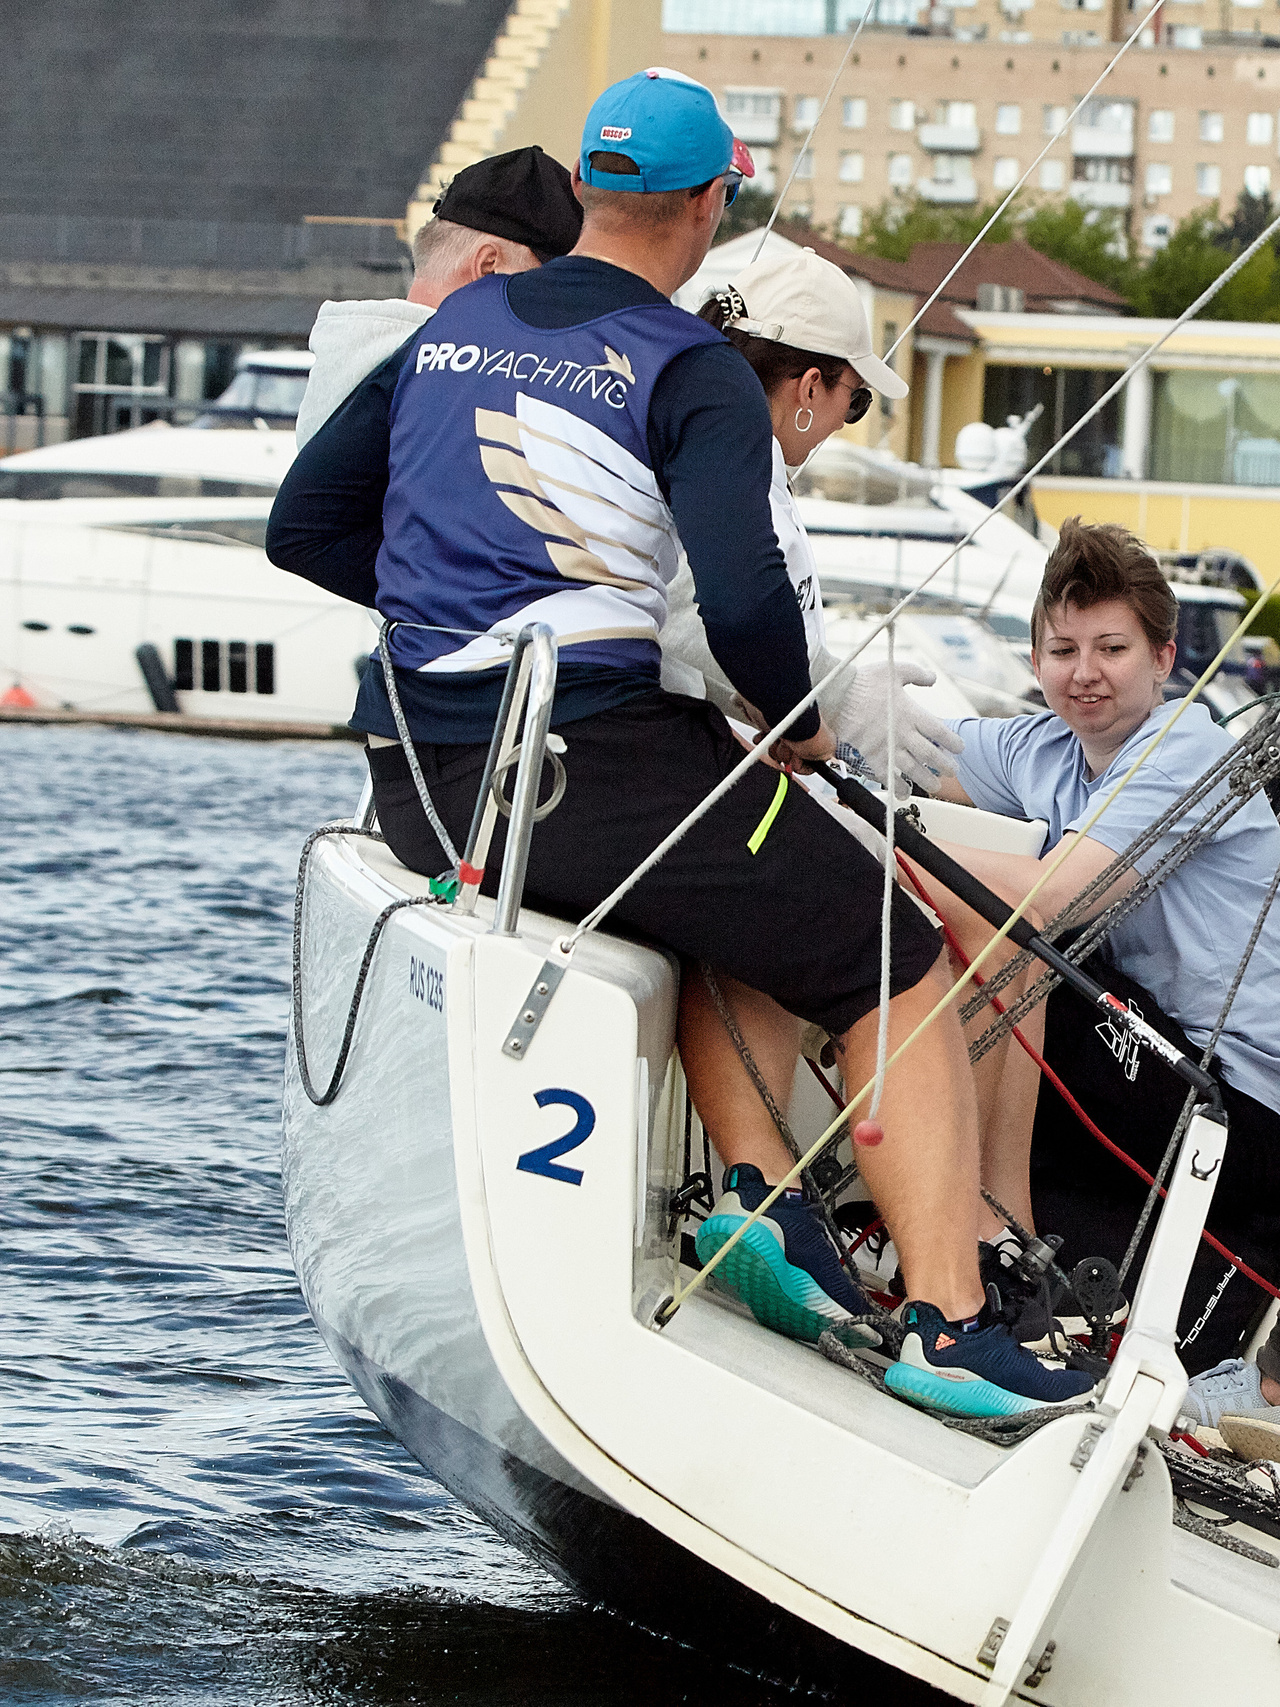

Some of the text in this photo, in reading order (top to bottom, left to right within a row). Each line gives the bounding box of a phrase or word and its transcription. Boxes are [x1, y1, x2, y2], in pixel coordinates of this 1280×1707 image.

[415, 342, 628, 410] PROYACHTING
[409, 955, 444, 1013] RUS 1235
[516, 1087, 597, 1187] 2
[1180, 1255, 1242, 1350] ARINEPOOL
